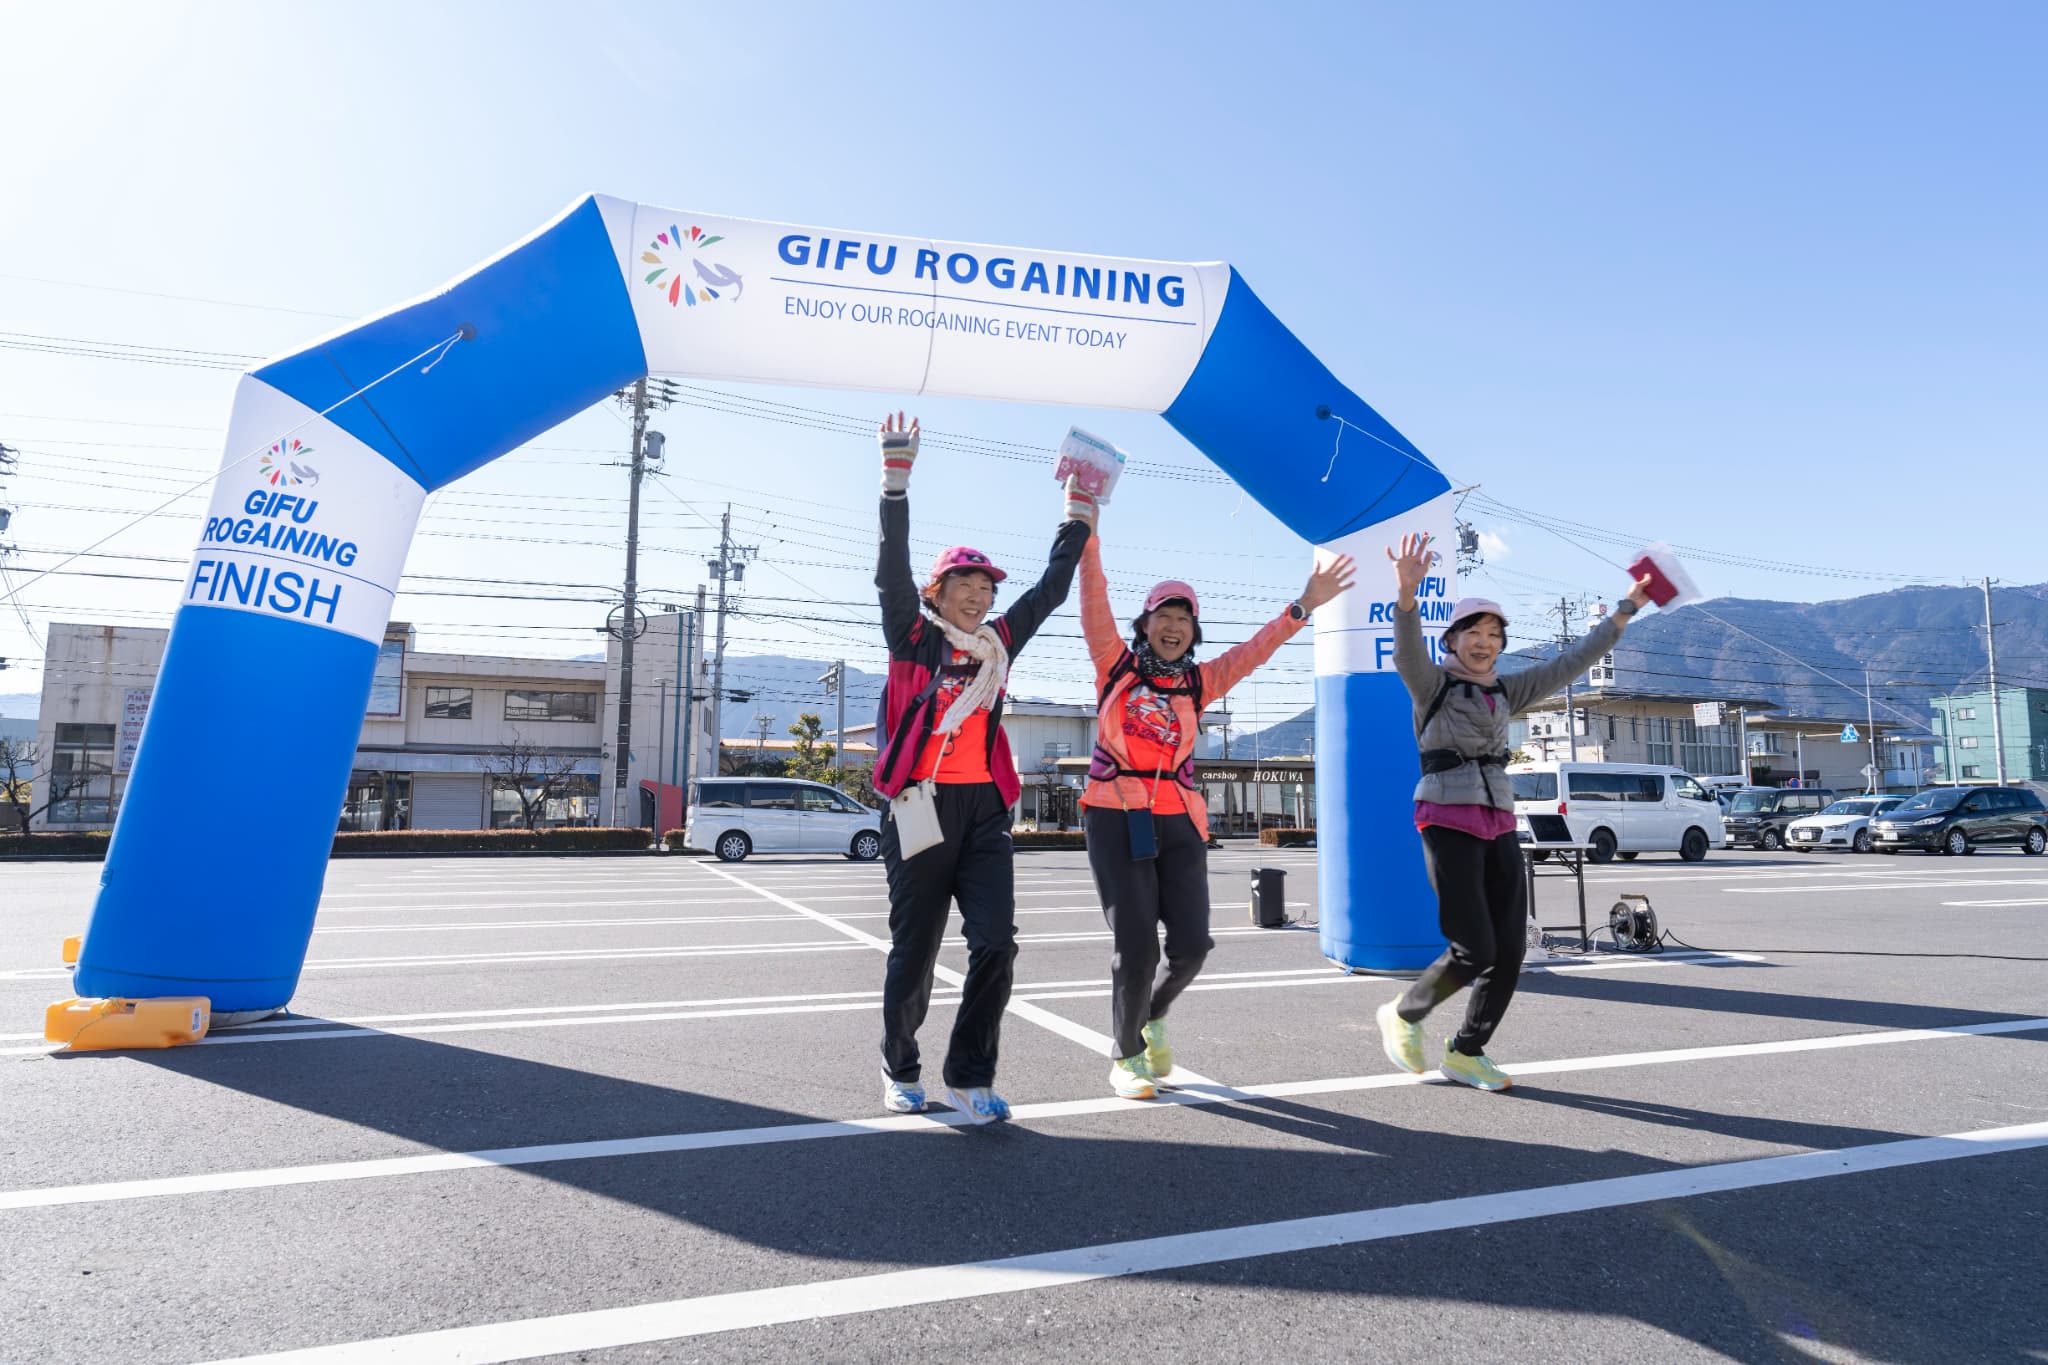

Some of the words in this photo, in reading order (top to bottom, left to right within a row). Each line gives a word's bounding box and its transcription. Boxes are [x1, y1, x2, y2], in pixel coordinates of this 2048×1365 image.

[778, 235, 897, 275] GIFU
[915, 249, 1184, 307] ROGAINING
[784, 296, 847, 320] ENJOY
[851, 304, 893, 325] OUR
[898, 308, 1000, 336] ROGAINING
[1005, 320, 1061, 343] EVENT
[1066, 327, 1127, 349] TODAY
[244, 490, 318, 523] GIFU
[202, 517, 358, 567] ROGAINING
[189, 560, 342, 624] FINISH
[1202, 771, 1237, 780] carshop
[1253, 770, 1304, 781] HOKUWA
